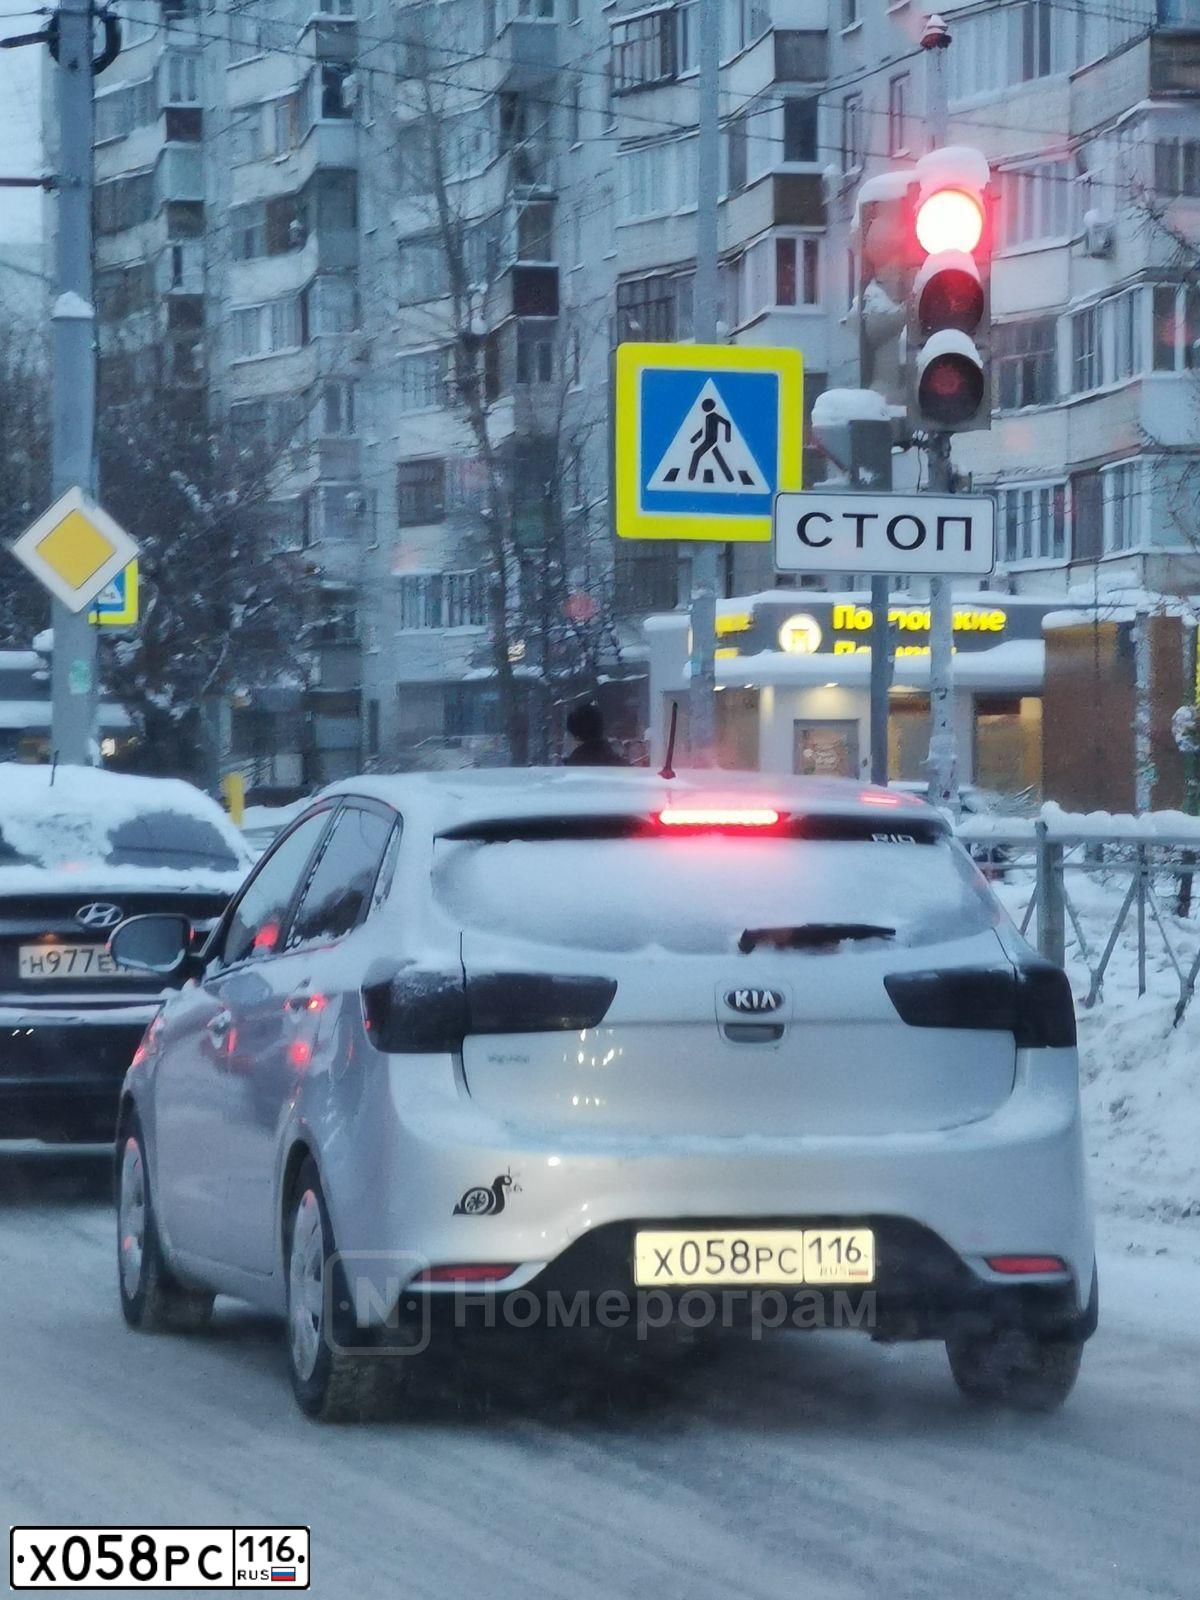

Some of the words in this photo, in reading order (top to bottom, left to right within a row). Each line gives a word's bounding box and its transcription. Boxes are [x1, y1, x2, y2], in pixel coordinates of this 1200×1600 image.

[797, 512, 972, 551] СТОП
[735, 990, 776, 1009] KIA
[653, 1239, 798, 1277] Х058РС
[808, 1236, 862, 1264] 116
